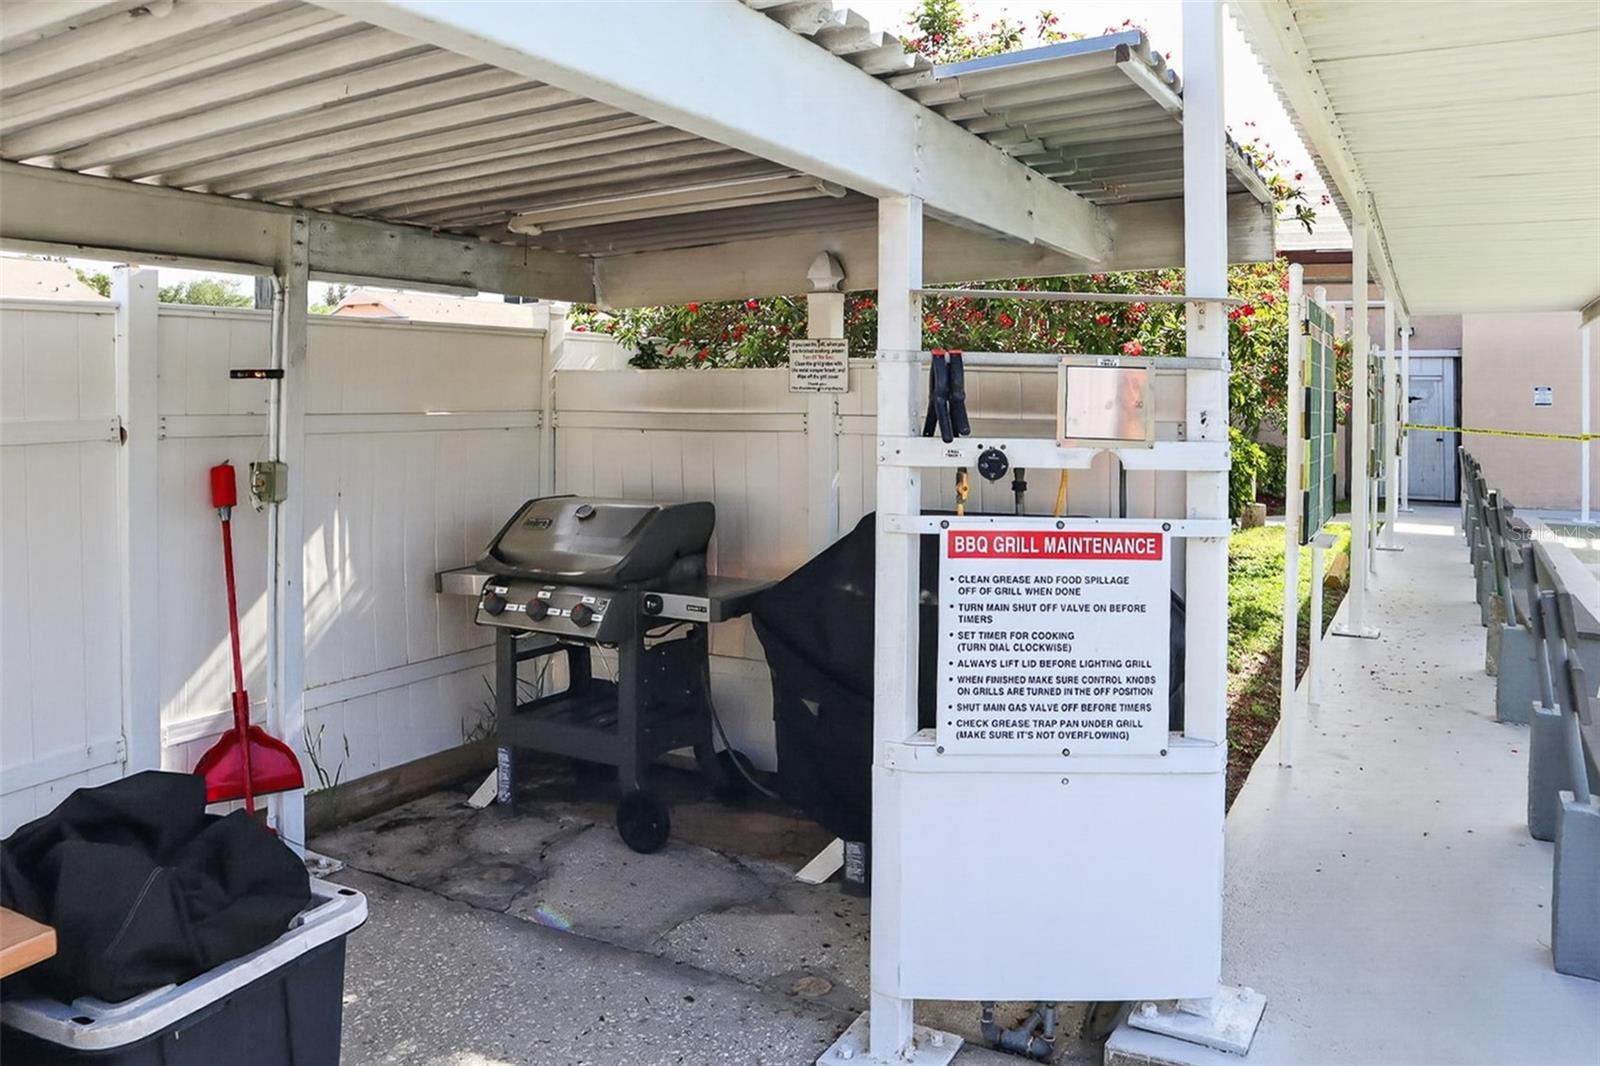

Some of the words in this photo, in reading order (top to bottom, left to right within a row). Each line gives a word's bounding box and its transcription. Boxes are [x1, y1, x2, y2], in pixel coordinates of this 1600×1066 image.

[955, 536, 988, 553] BBQ
[993, 536, 1039, 552] GRILL
[1045, 537, 1155, 554] MAINTENANCE
[958, 575, 990, 584] CLEAN
[992, 575, 1030, 584] GREASE
[1034, 576, 1053, 585] AND
[1056, 576, 1082, 585] FOOD
[1085, 576, 1129, 585] SPILLAGE
[958, 587, 976, 596] OFF
[979, 587, 992, 596] OF
[994, 587, 1021, 596] GRILL
[1025, 587, 1052, 596] WHEN
[1055, 587, 1080, 596] DONE
[959, 603, 983, 612] TURN
[986, 604, 1009, 612] MAIN
[1012, 603, 1037, 612] SHUT
[1040, 604, 1057, 613] OFF
[1061, 604, 1090, 613] VALVE
[1093, 604, 1106, 613] ON
[1110, 604, 1146, 613] BEFORE
[958, 615, 993, 624] TIMERS
[958, 631, 976, 640] SET
[978, 631, 1007, 640] TIMER
[1010, 632, 1029, 641] FOR
[1031, 632, 1074, 641] COOKING
[957, 643, 986, 653] (TURN
[989, 643, 1010, 652] DIAL
[1013, 643, 1071, 653] CLOCKWISE)
[958, 660, 997, 669] ALWAYS
[1000, 660, 1019, 669] LIFT
[1022, 660, 1037, 669] LID
[1040, 660, 1076, 669] BEFORE
[1080, 660, 1122, 669] LIGHTING
[1125, 660, 1151, 669] GRILL
[957, 676, 983, 685] WHEN
[986, 676, 1026, 685] FINISHED
[1028, 676, 1053, 685] MAKE
[1056, 676, 1078, 685] SURE
[1081, 676, 1122, 685] CONTROL
[1126, 676, 1156, 685] KNOBS
[957, 687, 970, 696] ON
[972, 687, 1004, 696] GRILLS
[1007, 687, 1024, 696] ARE
[1027, 687, 1061, 696] TURNED
[1064, 688, 1073, 696] IN
[1074, 688, 1090, 697] THE
[1093, 688, 1110, 697] OFF
[1113, 687, 1153, 696] POSITION
[957, 703, 980, 712] SHUT
[983, 704, 1006, 712] MAIN
[1008, 703, 1027, 712] GAS
[1029, 703, 1058, 712] VALVE
[1061, 703, 1078, 712] OFF
[1081, 703, 1116, 712] BEFORE
[1119, 703, 1152, 712] TIMERS
[956, 719, 988, 728] CHECK
[992, 719, 1030, 728] GREASE
[1033, 720, 1057, 728] TRAP
[1060, 720, 1079, 728] PAN
[1081, 720, 1113, 729] UNDER
[1116, 720, 1143, 729] GRILL
[956, 731, 986, 740] (MAKE
[989, 731, 1014, 740] SURE
[1017, 731, 1033, 740] IT'S
[1036, 731, 1055, 740] NOT
[1058, 731, 1129, 741] OVERFLOWING)
